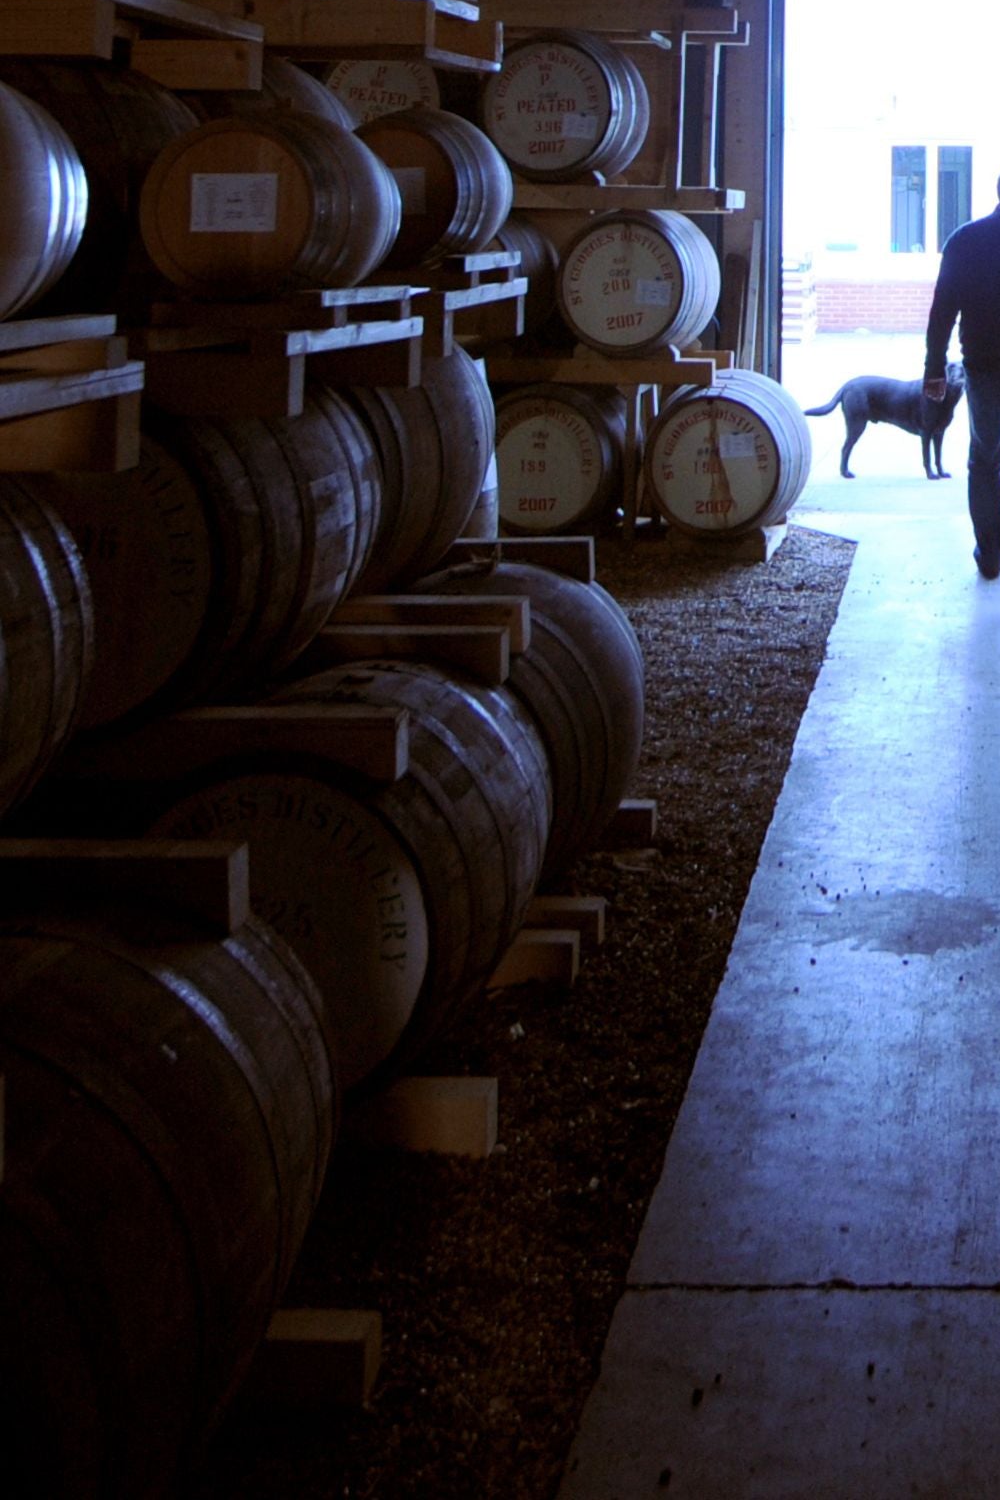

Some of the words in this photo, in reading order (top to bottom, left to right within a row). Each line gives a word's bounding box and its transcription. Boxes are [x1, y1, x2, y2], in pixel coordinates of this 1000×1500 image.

[496, 53, 543, 99] GEORGES
[547, 51, 603, 111] DISTILLERY
[540, 73, 550, 86] P
[349, 87, 408, 106] PEATED
[516, 99, 577, 114] PEATED
[528, 139, 567, 155] 2007
[570, 232, 616, 282] GEORGES
[620, 231, 675, 280] DISTILLER
[602, 278, 631, 296] 200
[570, 289, 582, 306] ST
[606, 312, 645, 331] 2007
[548, 407, 593, 477] DISTILLERY
[664, 410, 714, 457] GEORGES
[715, 409, 769, 473] DISTILLERY
[662, 465, 674, 481] ST
[519, 498, 557, 512] 2007
[696, 500, 734, 515] 2007
[272, 790, 407, 968] DISTILLERY
